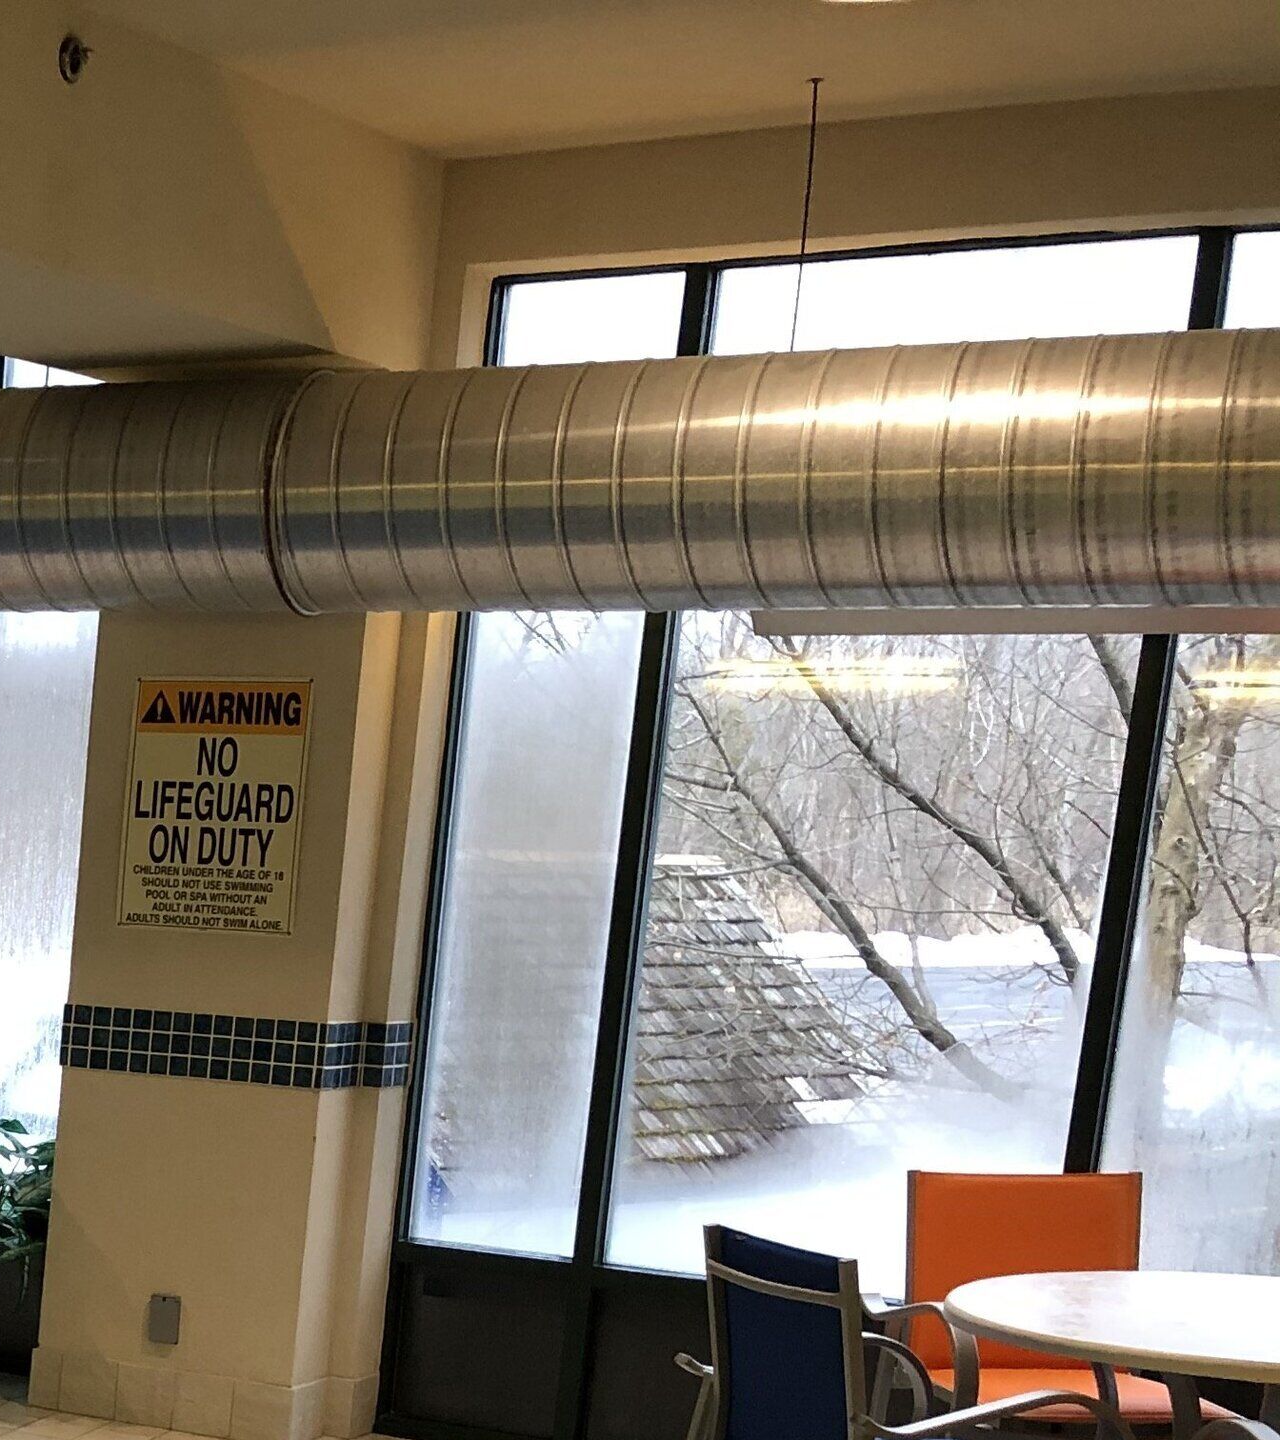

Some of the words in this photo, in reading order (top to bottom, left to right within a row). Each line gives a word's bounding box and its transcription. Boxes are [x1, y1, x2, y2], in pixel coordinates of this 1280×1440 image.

[179, 691, 301, 725] WARNING
[197, 737, 238, 777] NO
[135, 780, 294, 823] LIFEGUARD
[149, 825, 189, 864] ON
[198, 827, 273, 867] DUTY
[133, 865, 179, 876] CHILDREN
[182, 867, 214, 878] UNDER
[217, 869, 233, 878] THE
[236, 870, 255, 879] AGE
[258, 871, 271, 880] OF
[142, 878, 179, 888] SHOULD
[182, 880, 200, 889] NOT
[203, 881, 221, 890] USE
[225, 882, 273, 893] SWIMMING
[146, 890, 170, 900] POOL
[174, 891, 187, 900] OR
[190, 892, 207, 901] SPA
[210, 893, 252, 904] WITHOUT
[254, 895, 267, 905] AN
[152, 902, 181, 912] ADULT
[184, 904, 192, 913] IN
[194, 904, 257, 916] ATTENDANCE.
[126, 913, 160, 923] ADULTS
[162, 915, 200, 926] SHOULD
[202, 917, 221, 927] NOT
[224, 918, 248, 928] SWIM
